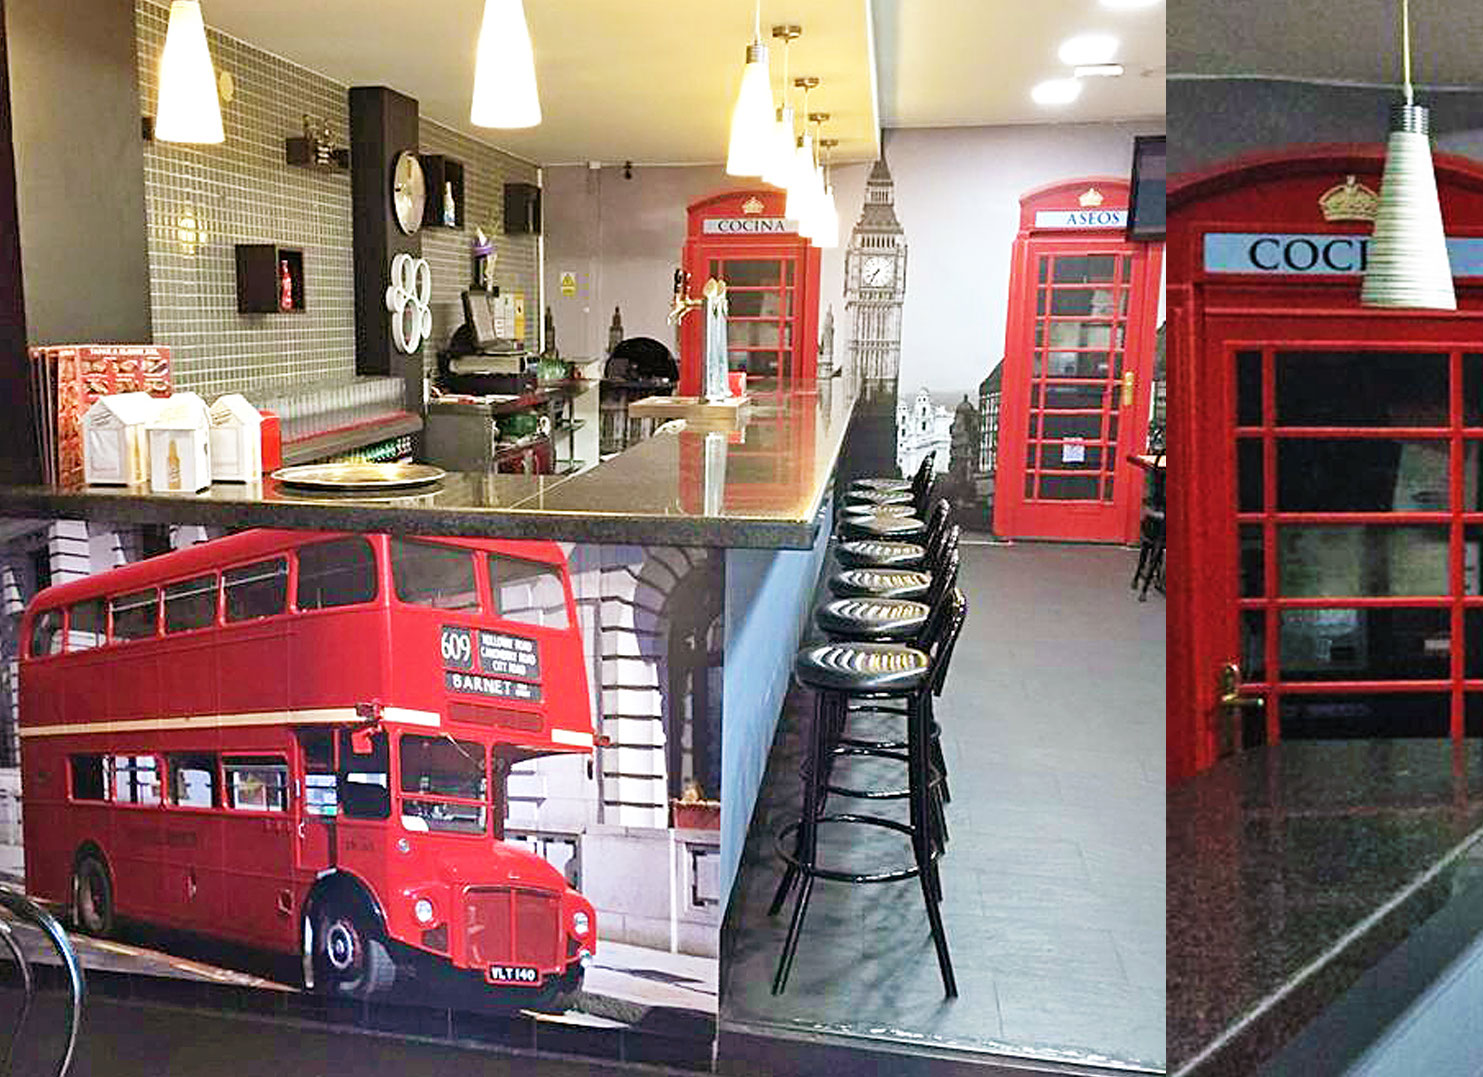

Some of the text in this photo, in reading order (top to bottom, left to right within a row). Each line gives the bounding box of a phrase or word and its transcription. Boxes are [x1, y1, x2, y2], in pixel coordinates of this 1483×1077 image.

[717, 220, 785, 232] COCINA
[1067, 212, 1121, 226] ASEOS
[1249, 238, 1369, 271] COCI
[441, 632, 471, 662] 609
[452, 673, 511, 696] BARNET
[491, 967, 536, 981] VLT 140
